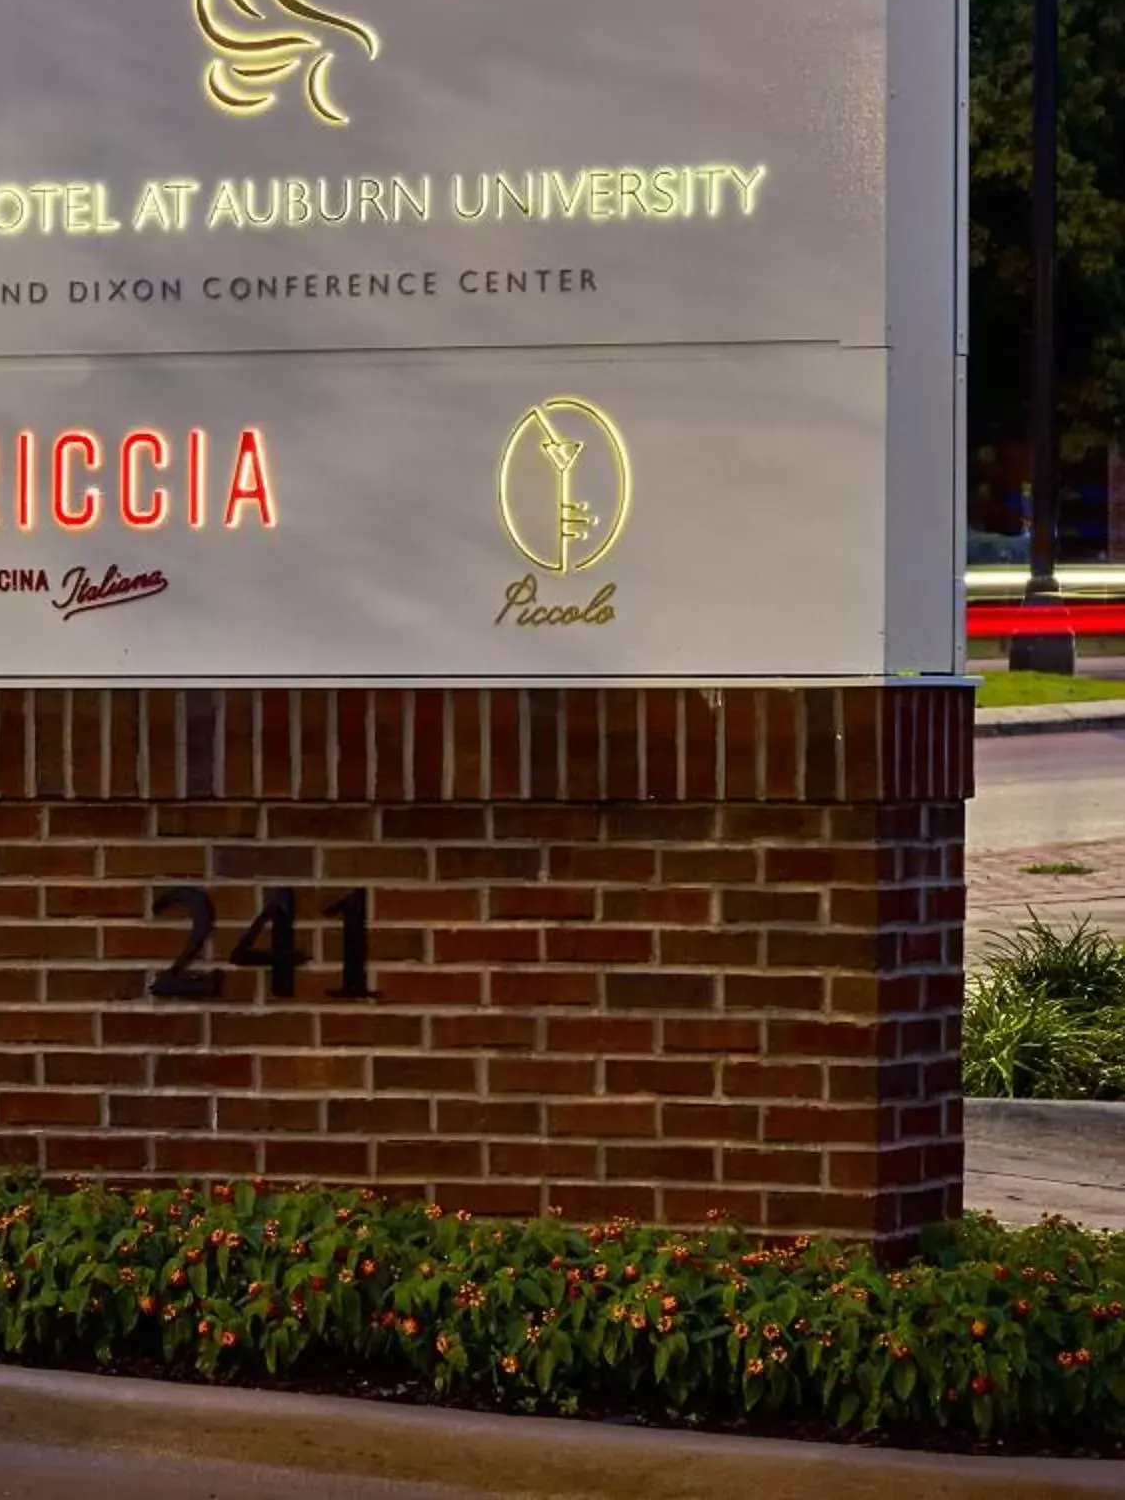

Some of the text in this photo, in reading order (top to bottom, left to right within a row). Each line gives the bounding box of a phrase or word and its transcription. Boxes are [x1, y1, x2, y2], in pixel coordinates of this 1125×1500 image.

[134, 178, 201, 231] AT
[207, 173, 430, 229] AUBURN
[452, 164, 768, 222] UNIVERSITY
[69, 278, 182, 303] DIXON
[202, 271, 437, 301] CONFERENCE
[458, 268, 599, 294] CENTER
[51, 564, 169, 620] Italiana
[494, 573, 618, 626] Piccolo
[148, 885, 383, 998] 241
